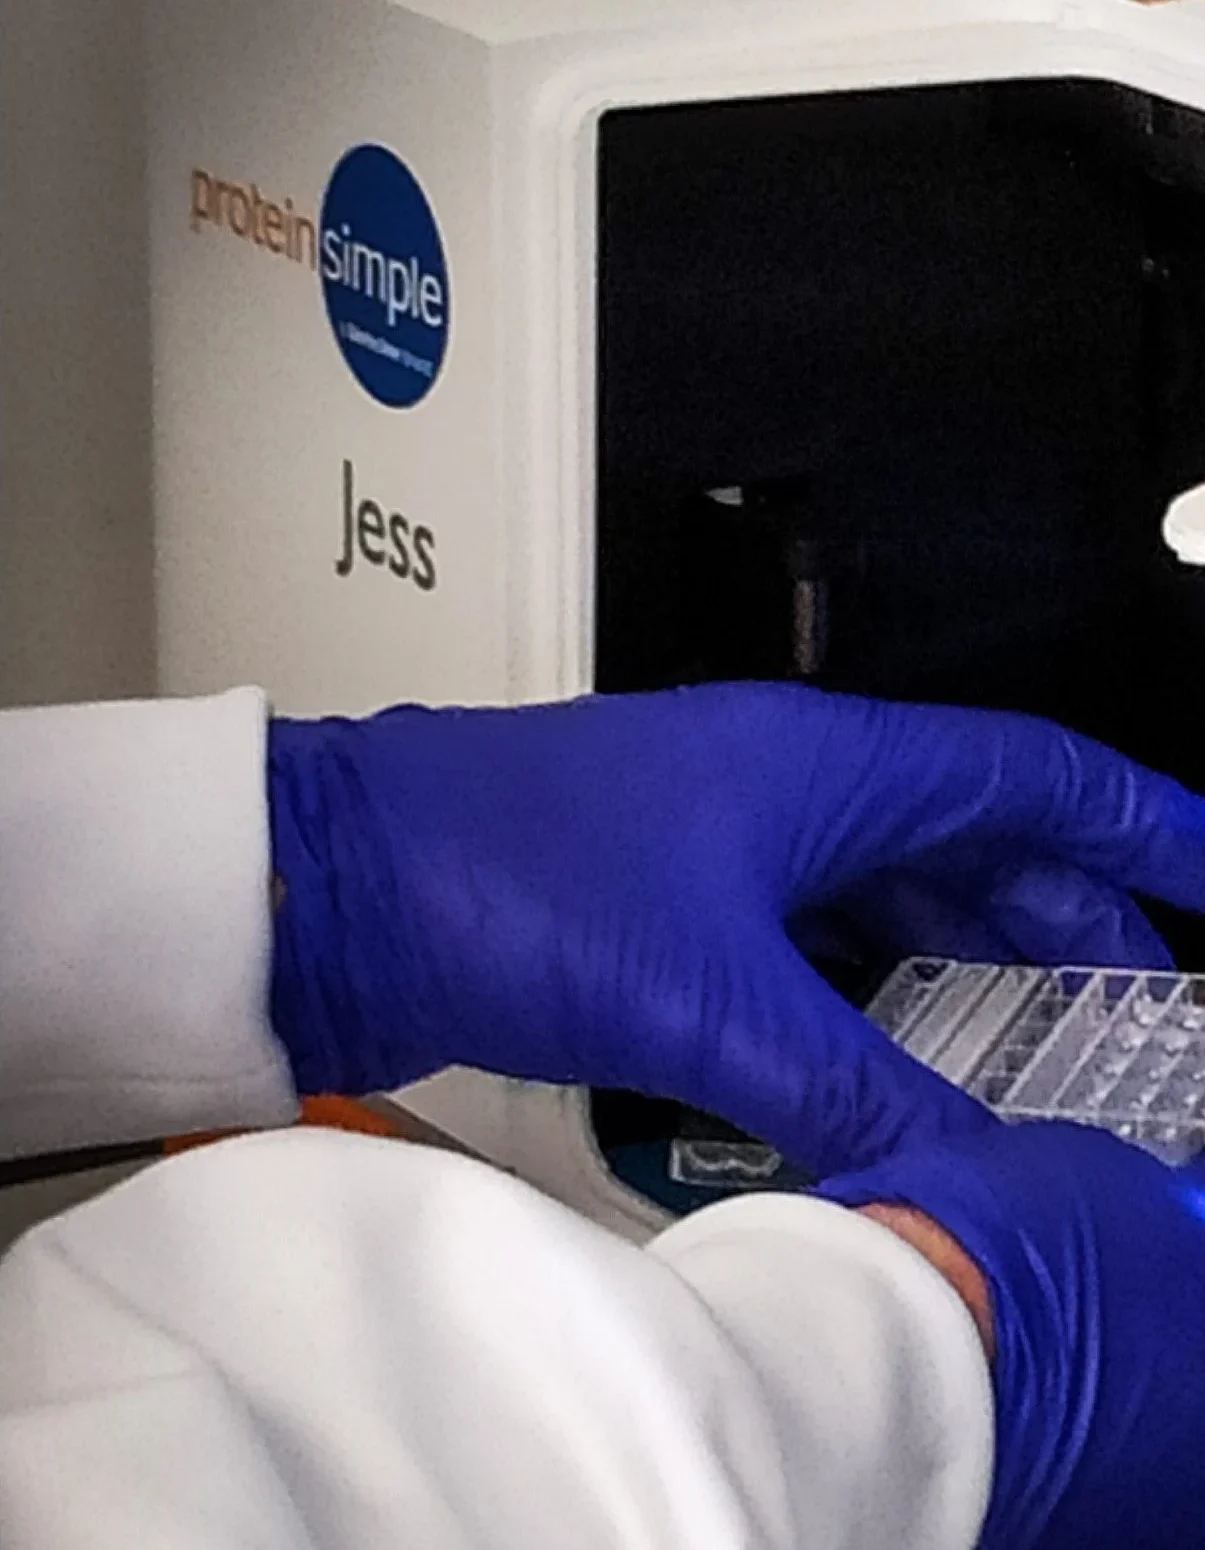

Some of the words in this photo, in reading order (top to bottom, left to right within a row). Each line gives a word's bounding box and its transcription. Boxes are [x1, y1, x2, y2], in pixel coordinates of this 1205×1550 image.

[190, 169, 318, 270] protein
[322, 222, 443, 327] simple
[335, 458, 437, 591] Jess
